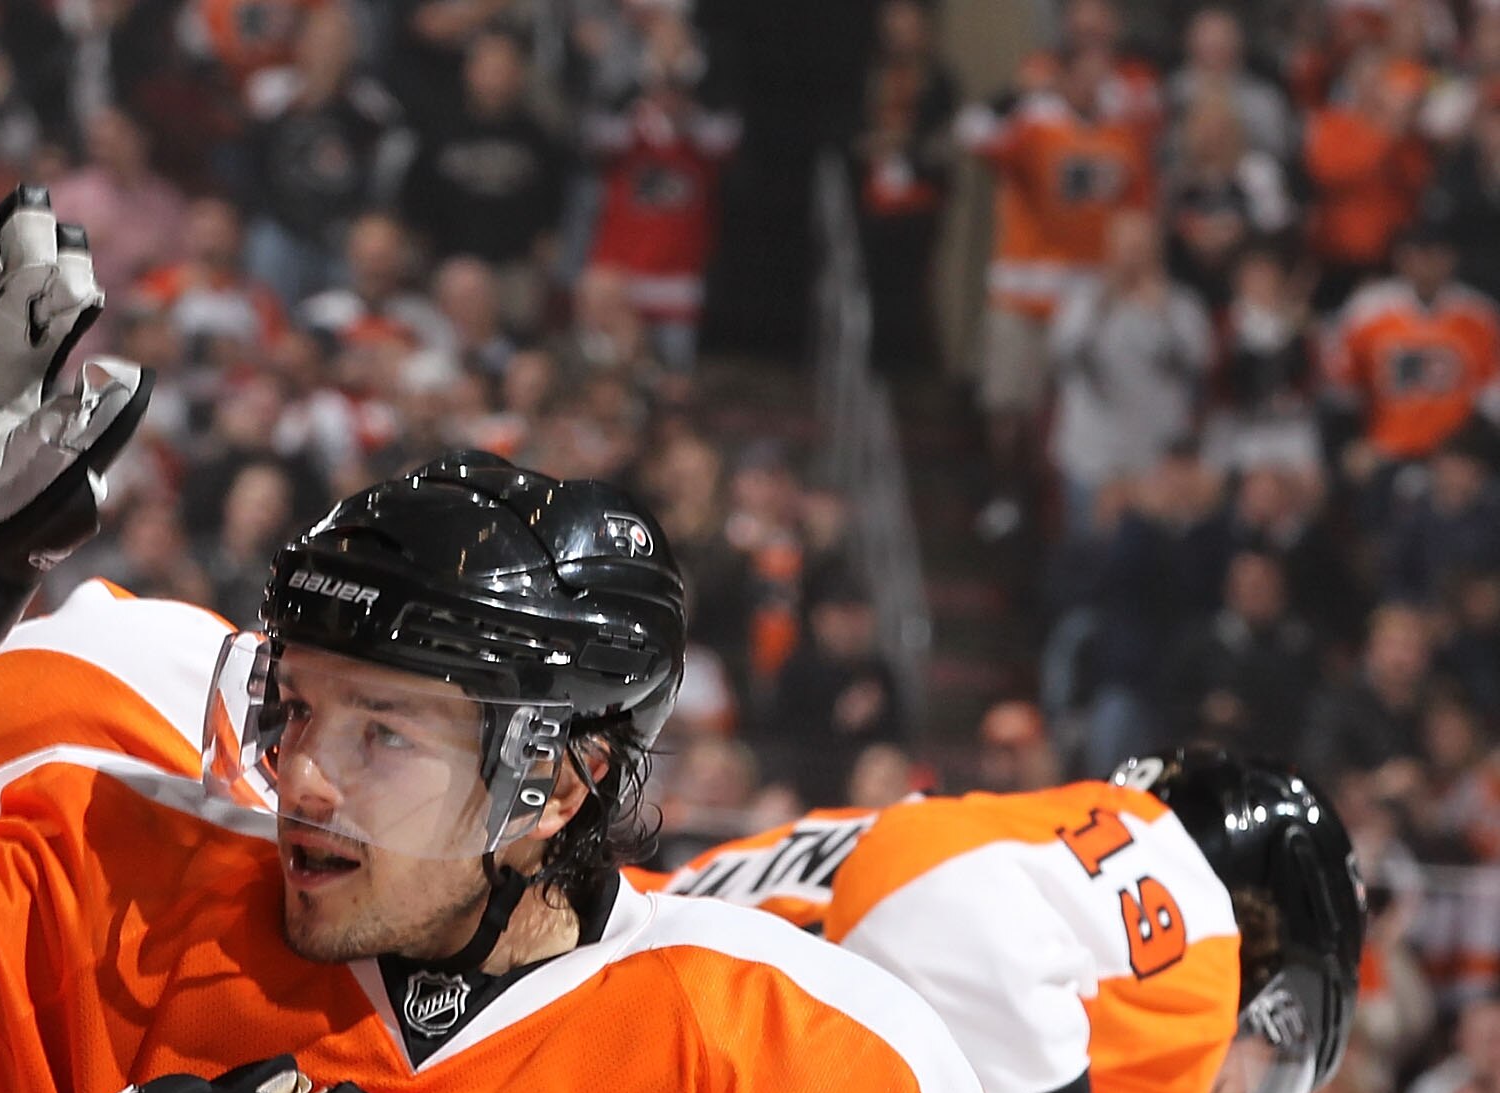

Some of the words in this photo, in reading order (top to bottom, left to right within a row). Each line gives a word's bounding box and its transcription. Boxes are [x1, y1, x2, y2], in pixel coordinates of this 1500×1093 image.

[288, 570, 380, 608] BAUER
[1054, 806, 1188, 979] 19
[417, 990, 457, 1019] NHL
